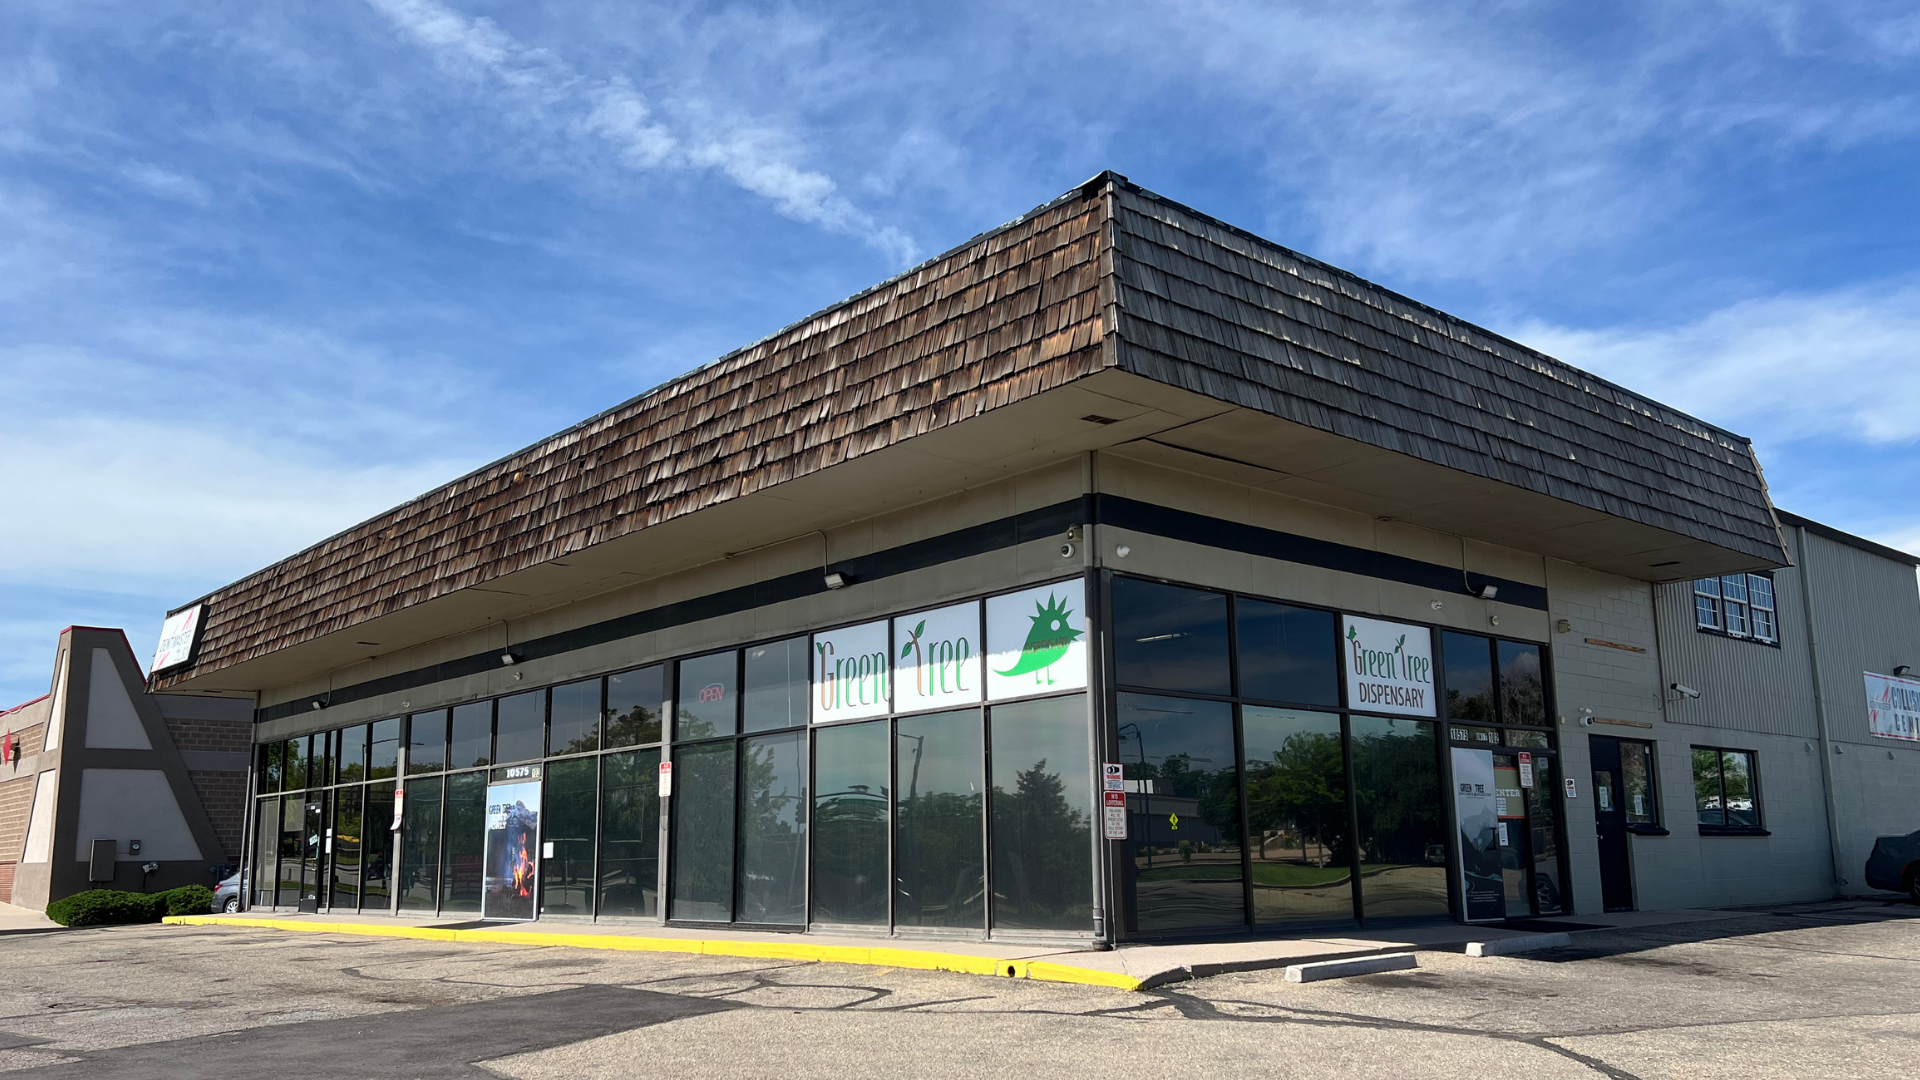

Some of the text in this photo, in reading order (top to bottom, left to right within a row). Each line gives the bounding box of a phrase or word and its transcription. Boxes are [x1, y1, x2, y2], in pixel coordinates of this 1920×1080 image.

[818, 620, 970, 711] Green Tree
[1350, 634, 1431, 684] Green Tree
[699, 686, 723, 703] OPEN
[1358, 682, 1425, 708] DISPENSARY
[506, 767, 530, 778] 10575
